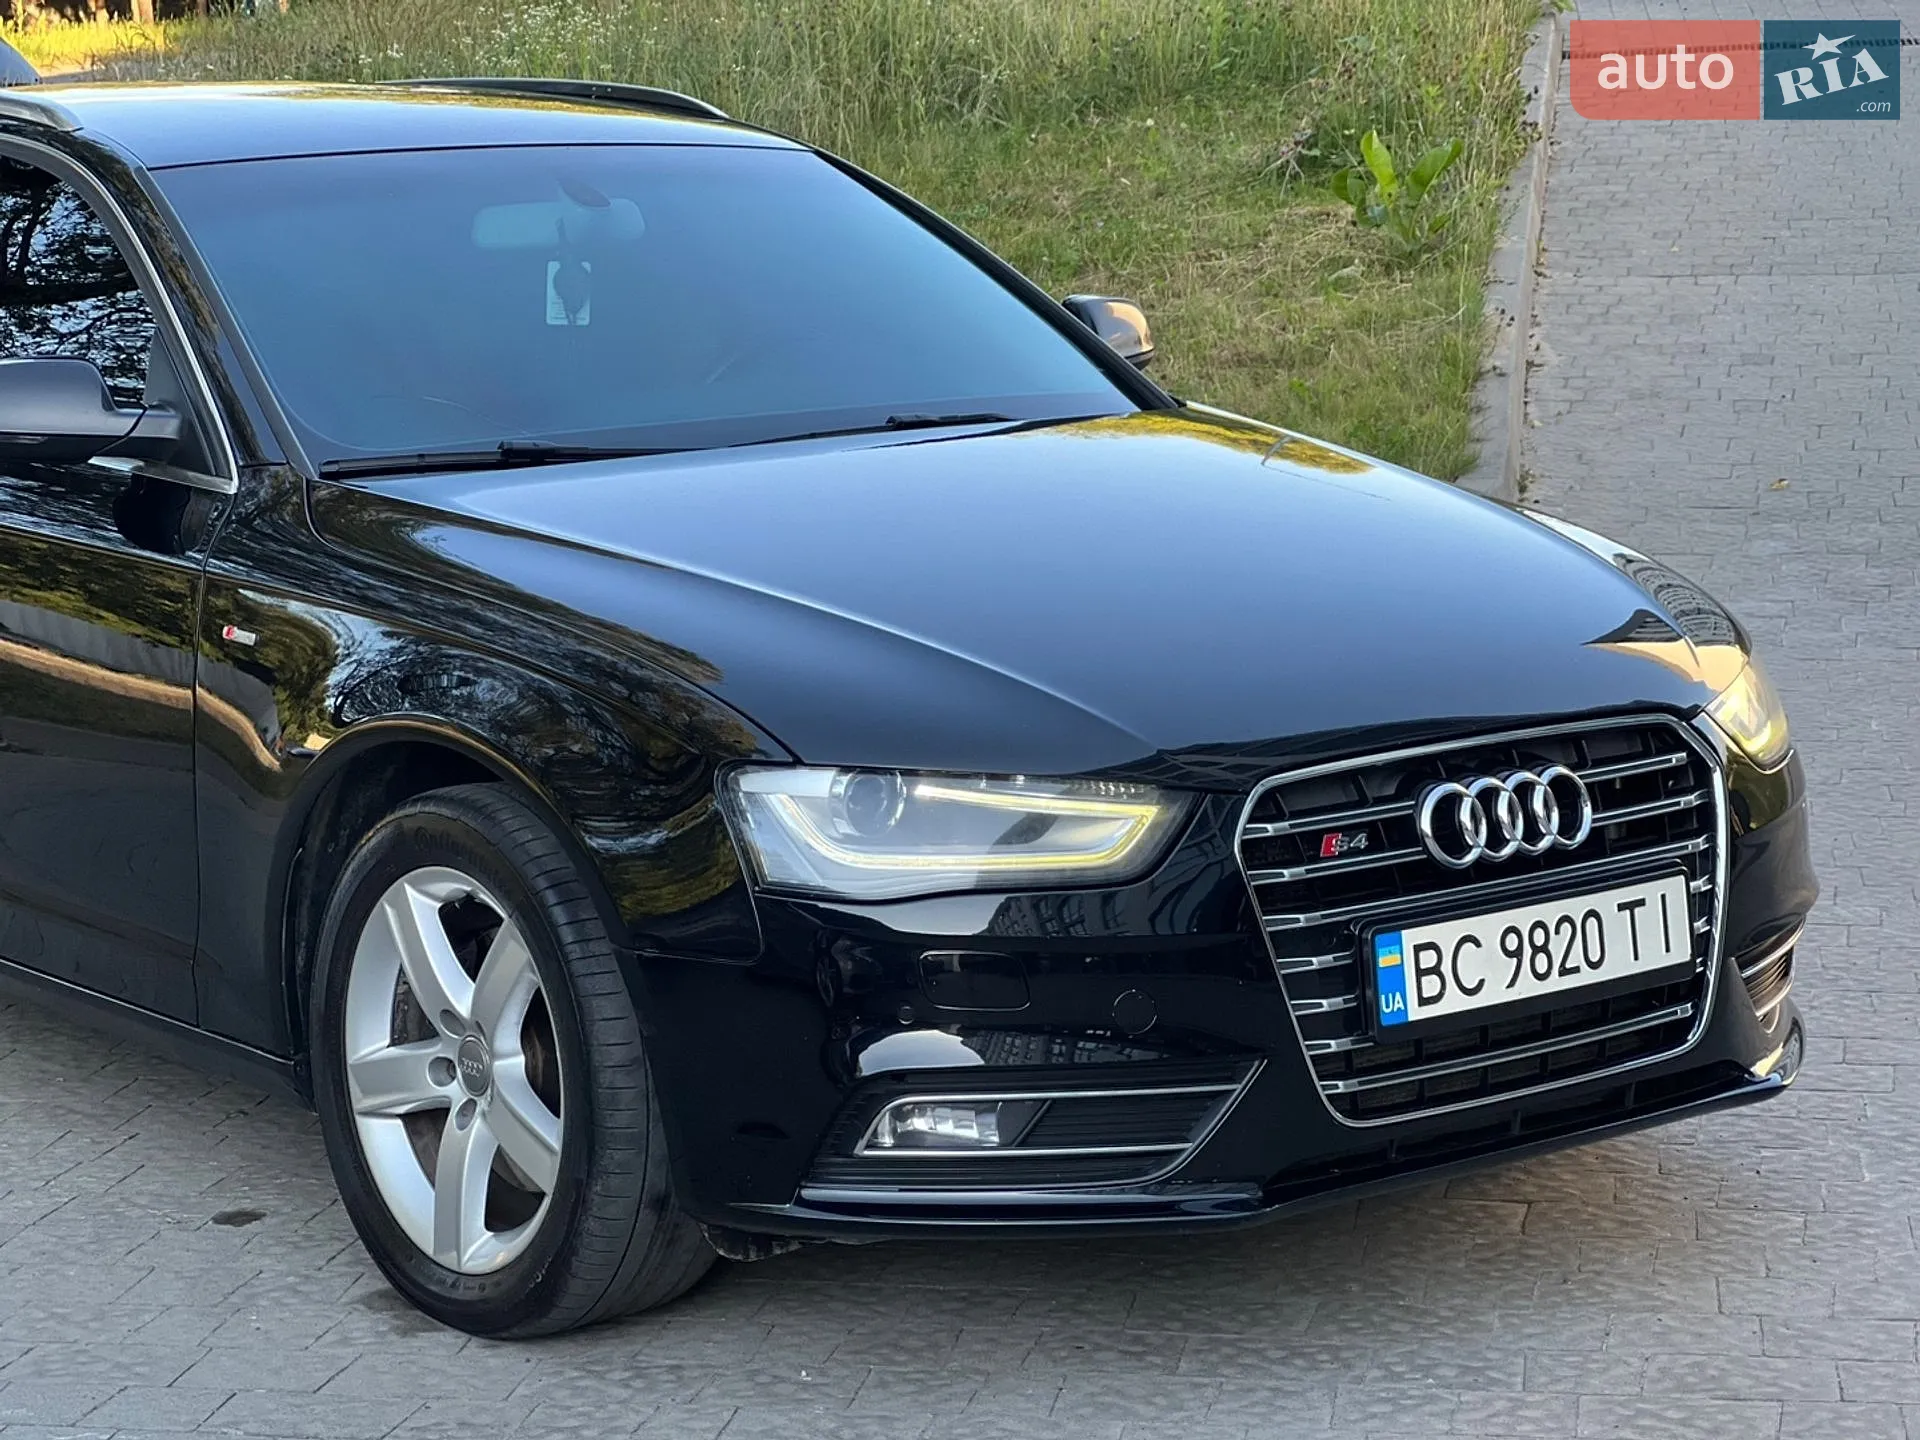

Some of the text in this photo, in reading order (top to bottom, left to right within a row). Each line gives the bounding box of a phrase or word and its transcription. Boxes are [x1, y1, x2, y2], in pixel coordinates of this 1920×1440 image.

[1331, 832, 1369, 852] S4
[1412, 893, 1671, 1008] BC 9820 TI
[1380, 993, 1405, 1014] UA
